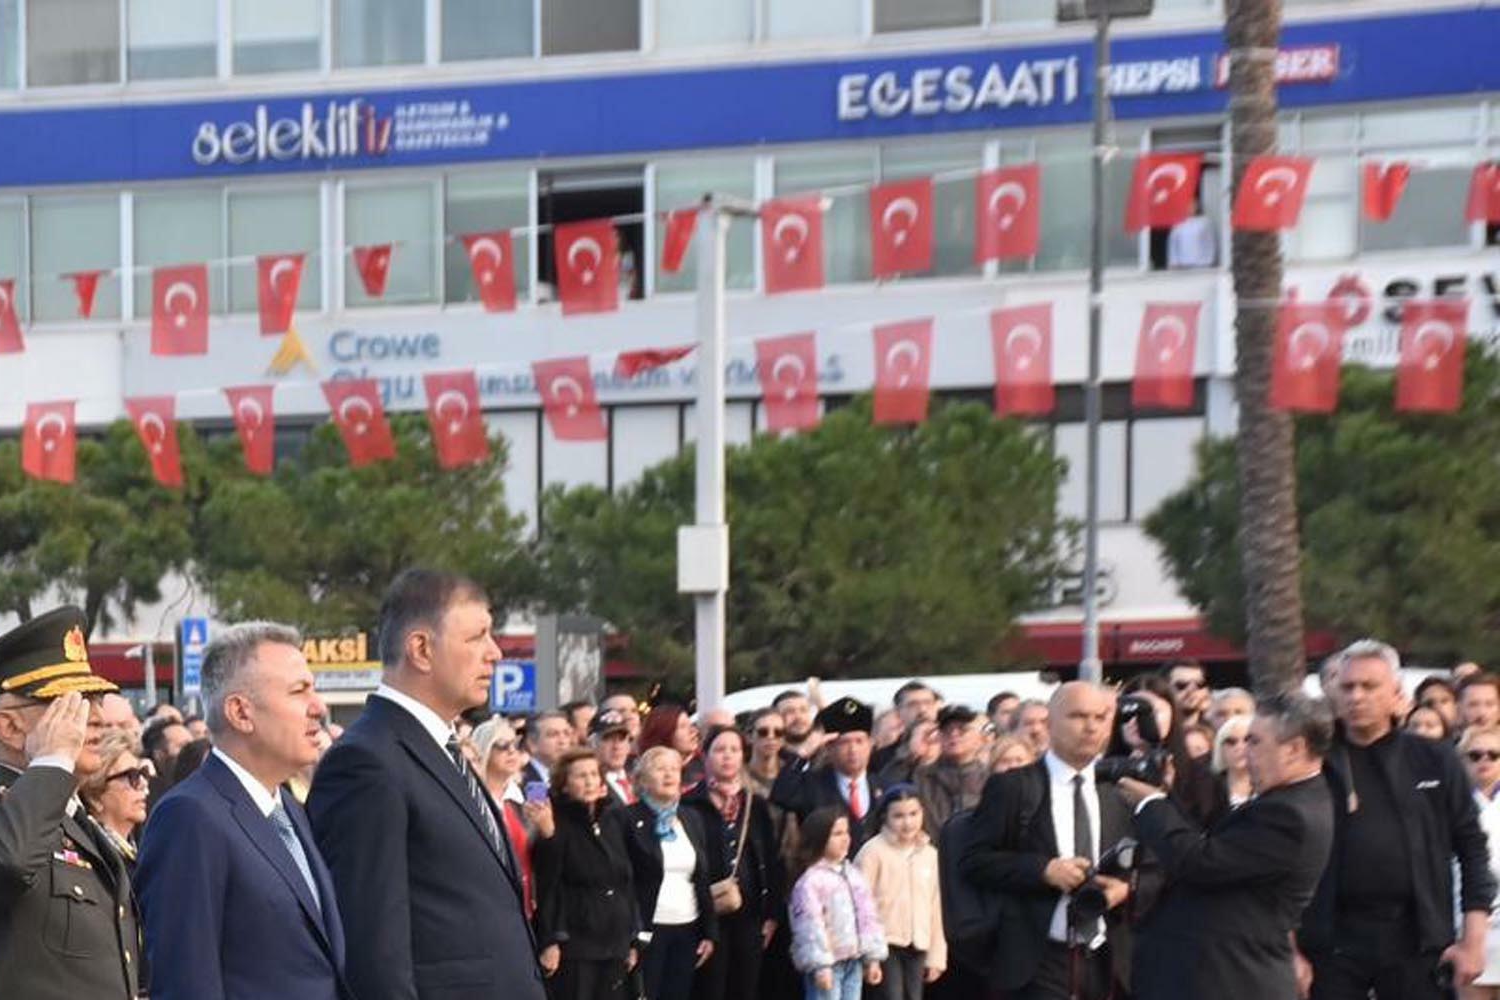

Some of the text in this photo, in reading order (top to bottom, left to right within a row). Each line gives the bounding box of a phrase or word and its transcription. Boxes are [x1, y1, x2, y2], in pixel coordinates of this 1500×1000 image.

[329, 329, 440, 363] Crowe
[302, 632, 368, 663] AKSİ
[495, 664, 525, 707] P
